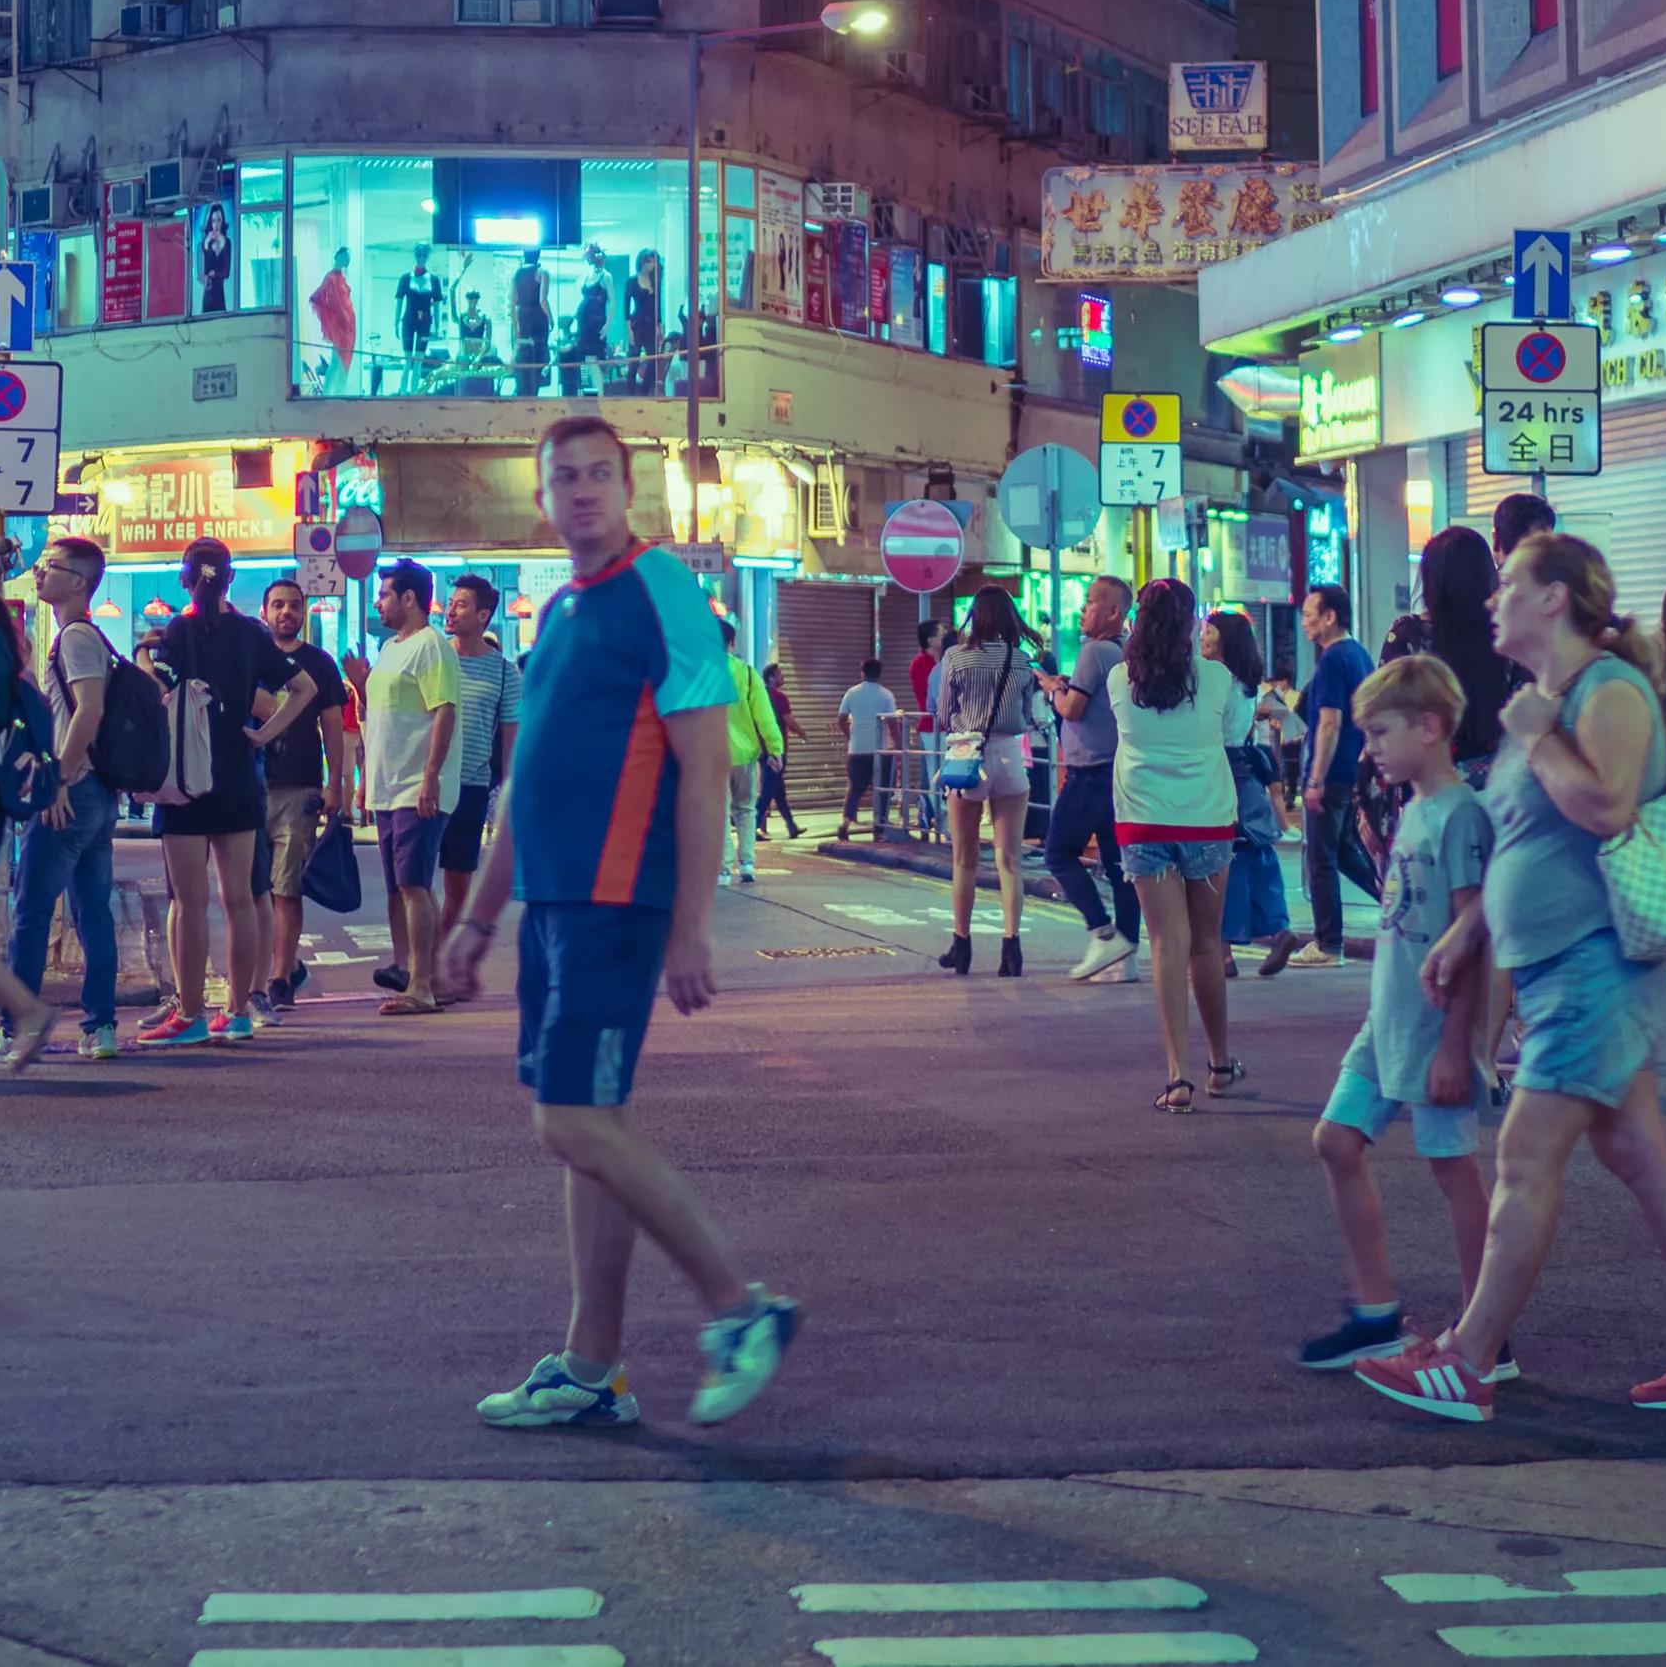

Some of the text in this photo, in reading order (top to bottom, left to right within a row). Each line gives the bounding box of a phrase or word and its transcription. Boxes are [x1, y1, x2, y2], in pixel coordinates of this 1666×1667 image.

[1499, 398, 1585, 425] 24 hrs
[16, 437, 36, 463] 7
[1151, 449, 1165, 468] 7
[1508, 433, 1574, 463] 全日
[1117, 457, 1139, 468] 上午
[15, 480, 34, 506] 7
[1117, 489, 1139, 500] 下午
[1152, 481, 1165, 500] 7
[122, 524, 156, 542] WAH
[164, 522, 196, 541] KEE
[203, 519, 273, 538] SNACKS
